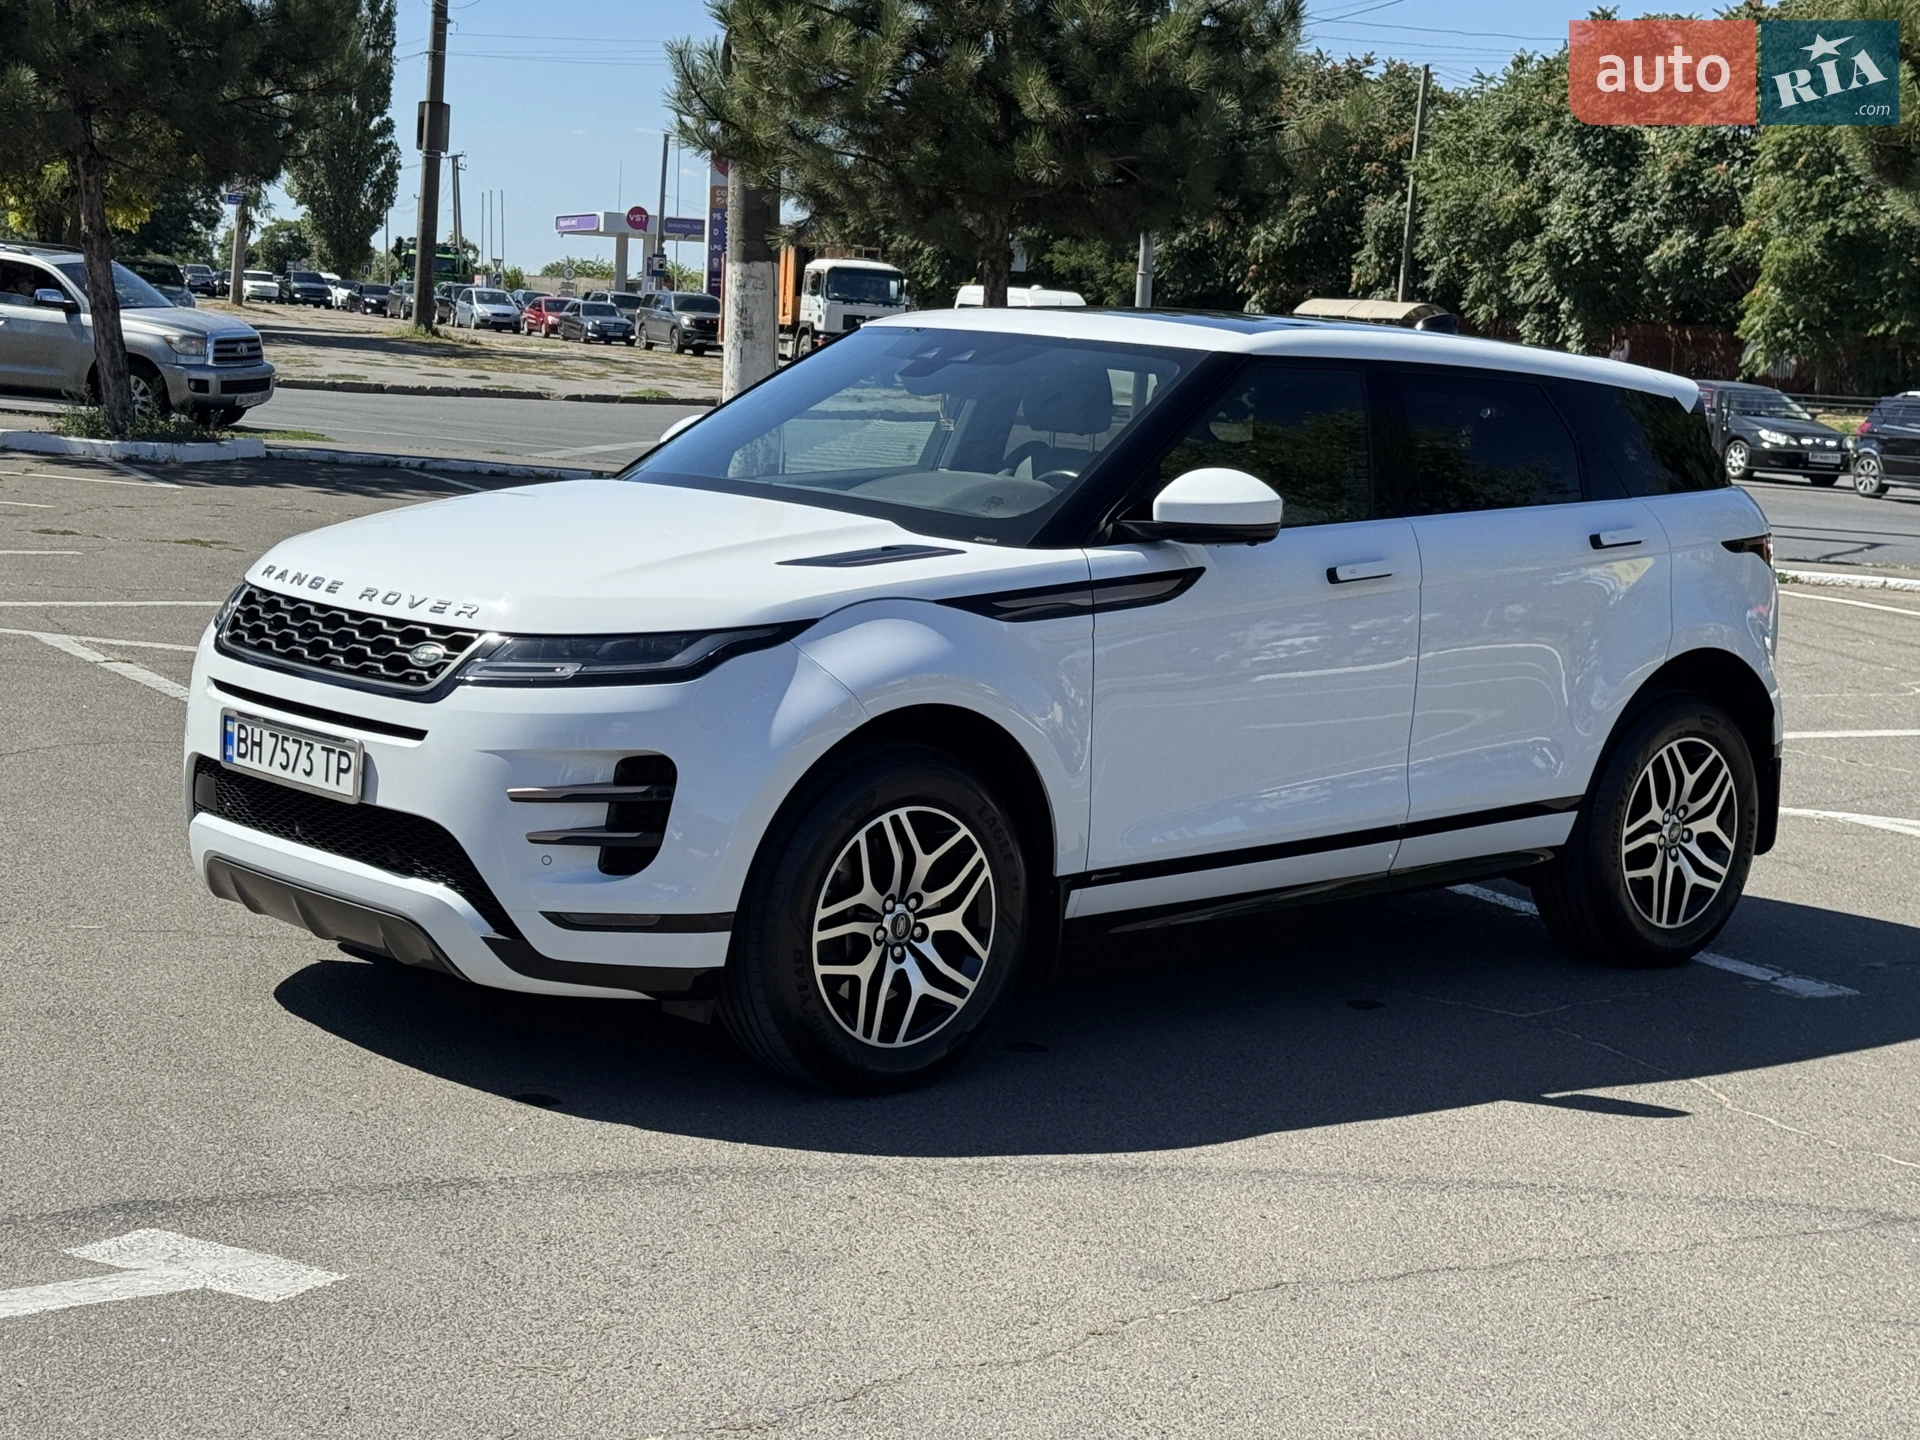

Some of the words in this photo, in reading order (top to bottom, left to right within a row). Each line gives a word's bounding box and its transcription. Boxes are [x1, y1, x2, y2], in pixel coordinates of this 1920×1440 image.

[628, 213, 647, 222] VST
[712, 212, 722, 221] 95
[713, 228, 719, 236] D
[261, 564, 344, 595] RANGE
[358, 587, 480, 619] ROVER
[236, 723, 263, 764] BH
[268, 731, 315, 778] 7573
[320, 745, 352, 786] TP
[976, 804, 1016, 865] EAGLE
